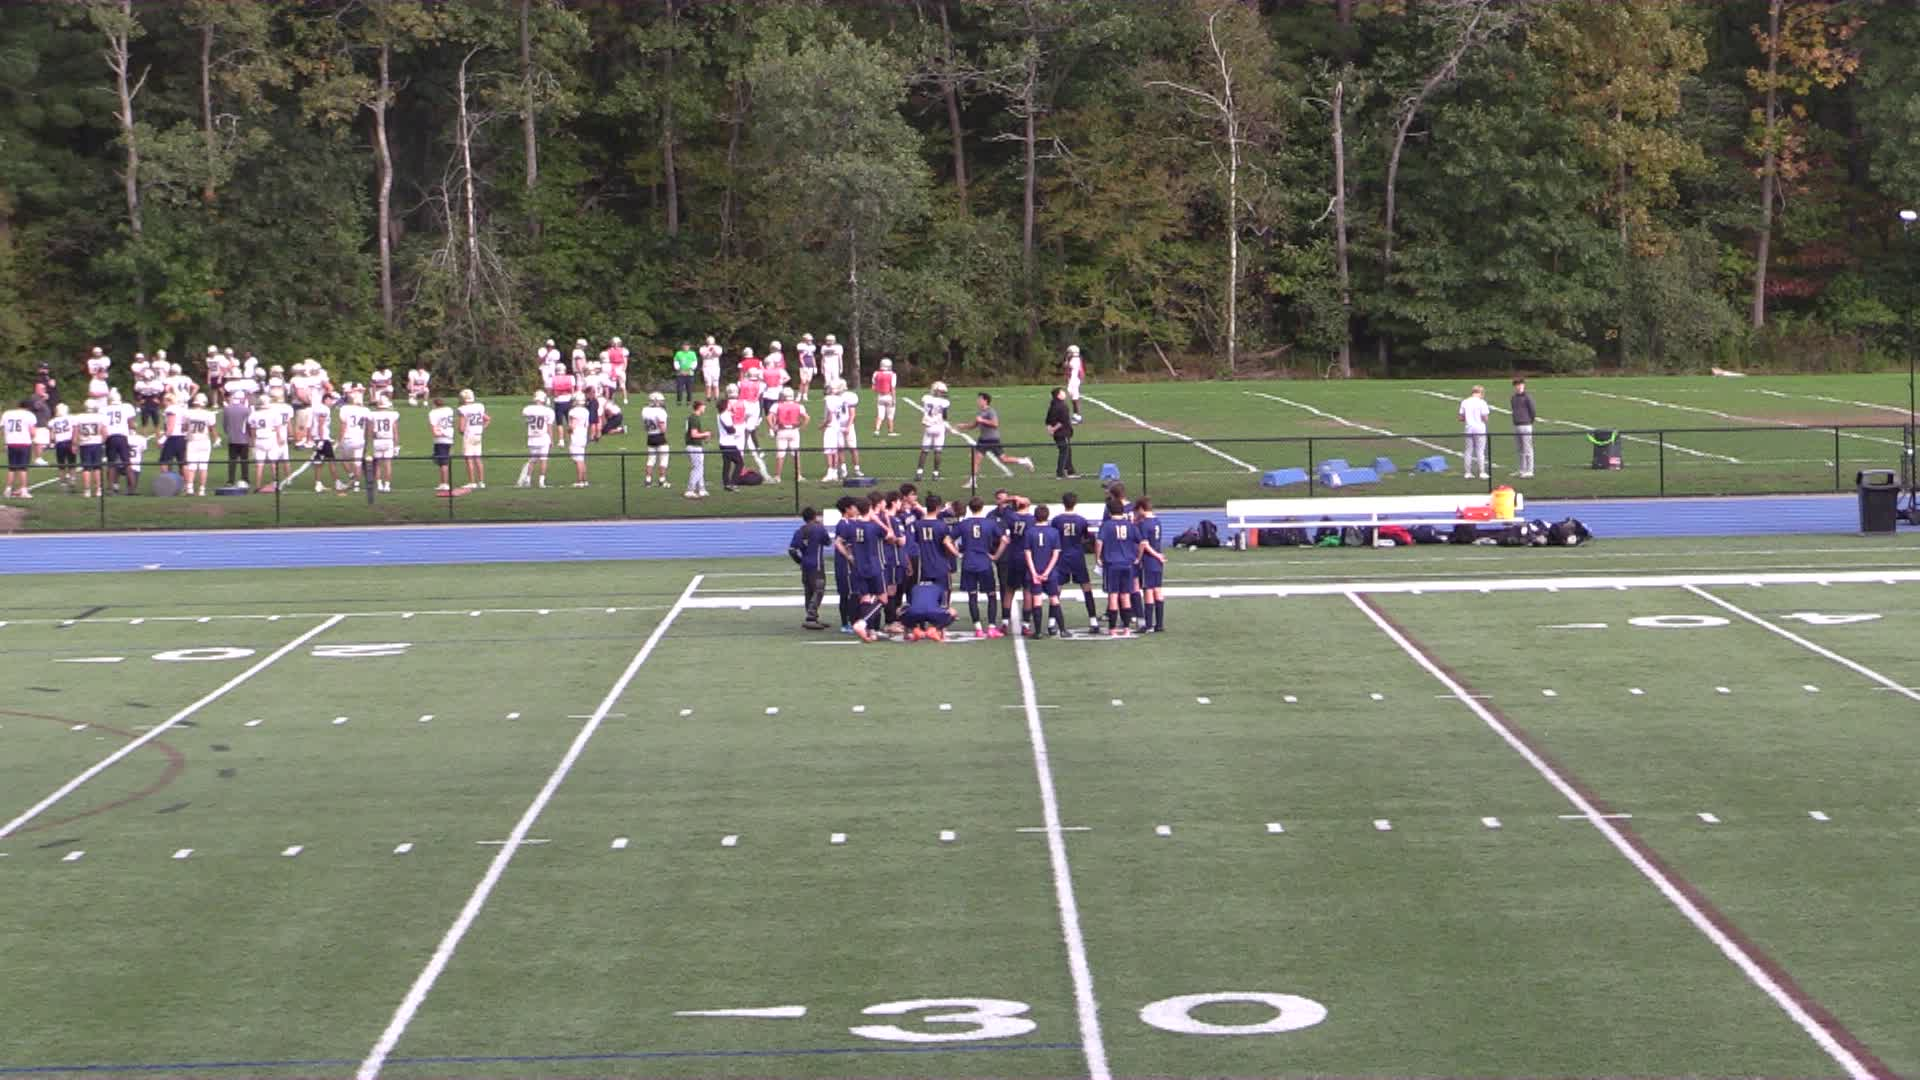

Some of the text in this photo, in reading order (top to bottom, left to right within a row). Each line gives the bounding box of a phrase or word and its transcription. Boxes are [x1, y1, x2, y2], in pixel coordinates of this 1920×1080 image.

[7, 419, 22, 433] 76
[972, 524, 982, 538] 6
[1063, 522, 1076, 536] 21
[1038, 532, 1044, 546] 1
